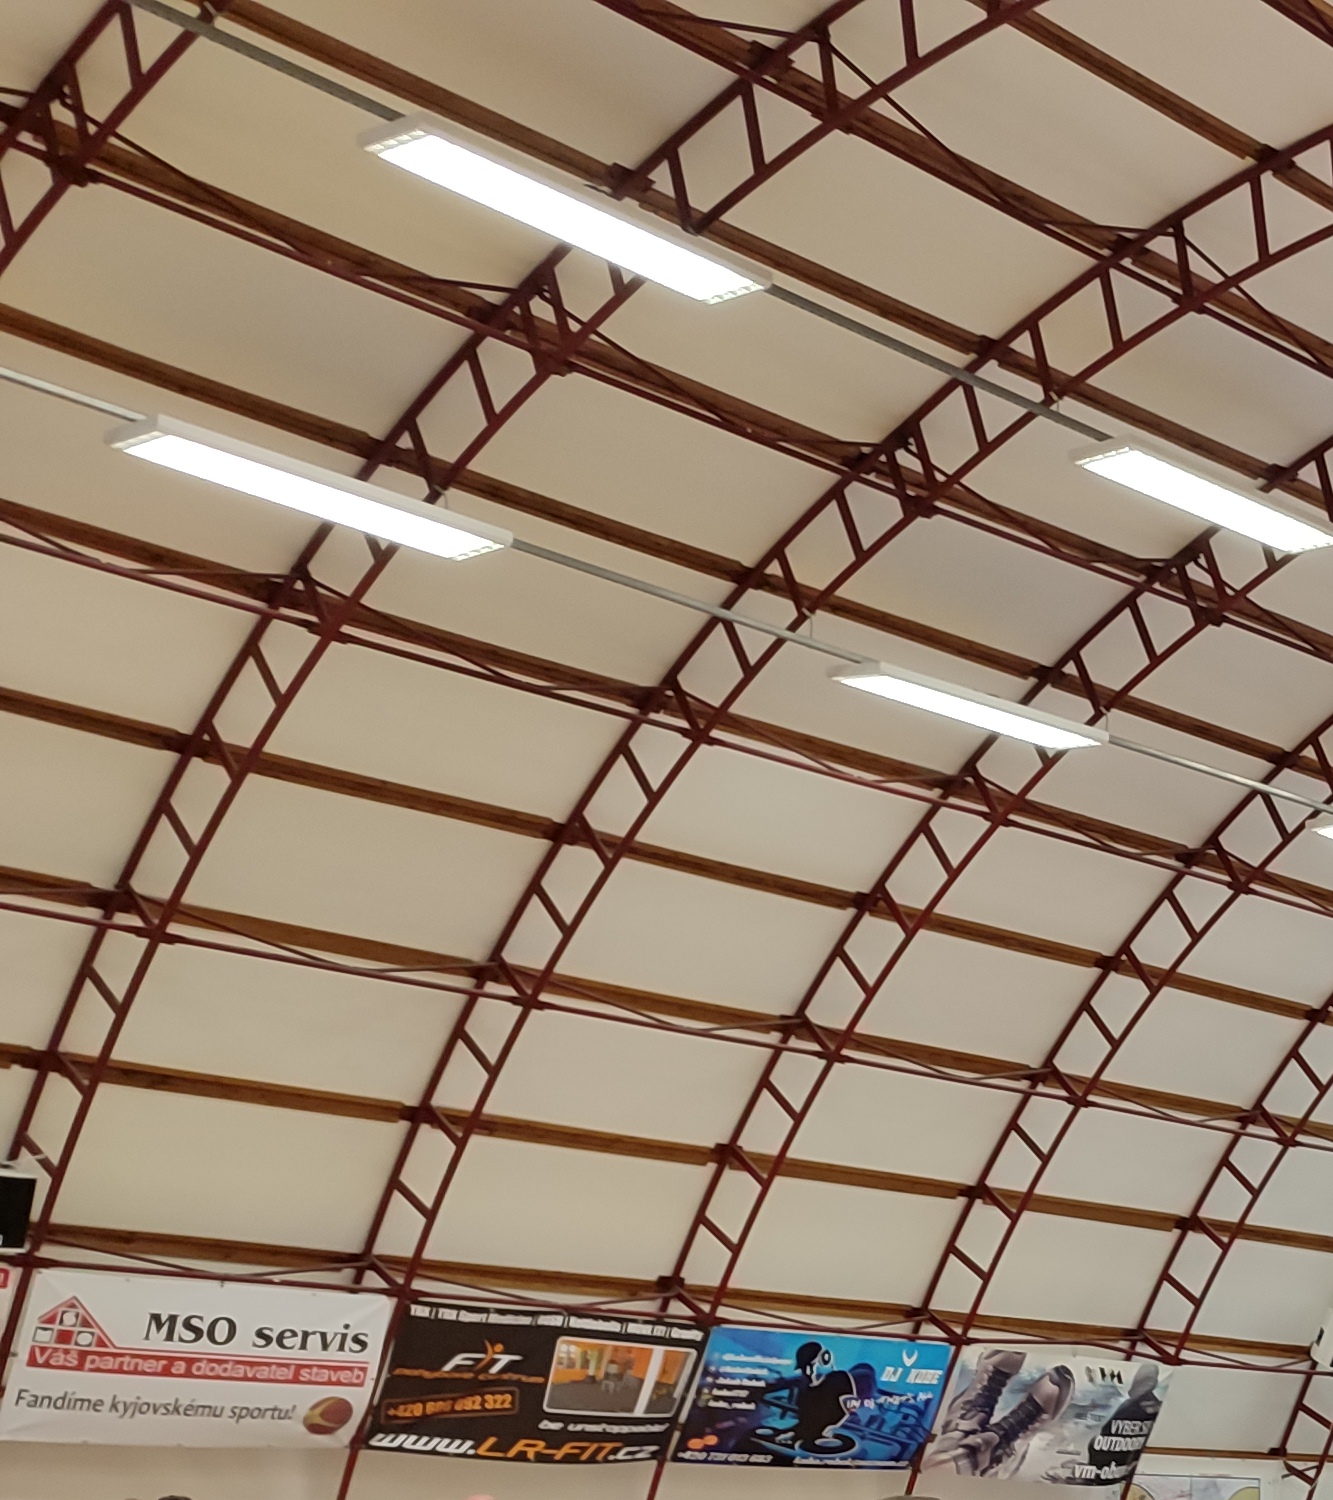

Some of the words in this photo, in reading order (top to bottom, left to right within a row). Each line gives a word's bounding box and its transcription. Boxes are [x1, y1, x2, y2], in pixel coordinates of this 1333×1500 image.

[143, 1312, 237, 1346] MSO
[252, 1323, 369, 1354] servis
[33, 1346, 79, 1368] Váš
[84, 1354, 168, 1372] partner
[170, 1361, 186, 1375] a
[191, 1359, 295, 1380] dodavatel
[299, 1366, 364, 1384] staveb
[14, 1388, 105, 1413] Fandíme
[108, 1394, 224, 1419] kyjovskému
[227, 1404, 297, 1424] sportu!
[368, 1433, 660, 1463] www.LR-FIT.cz
